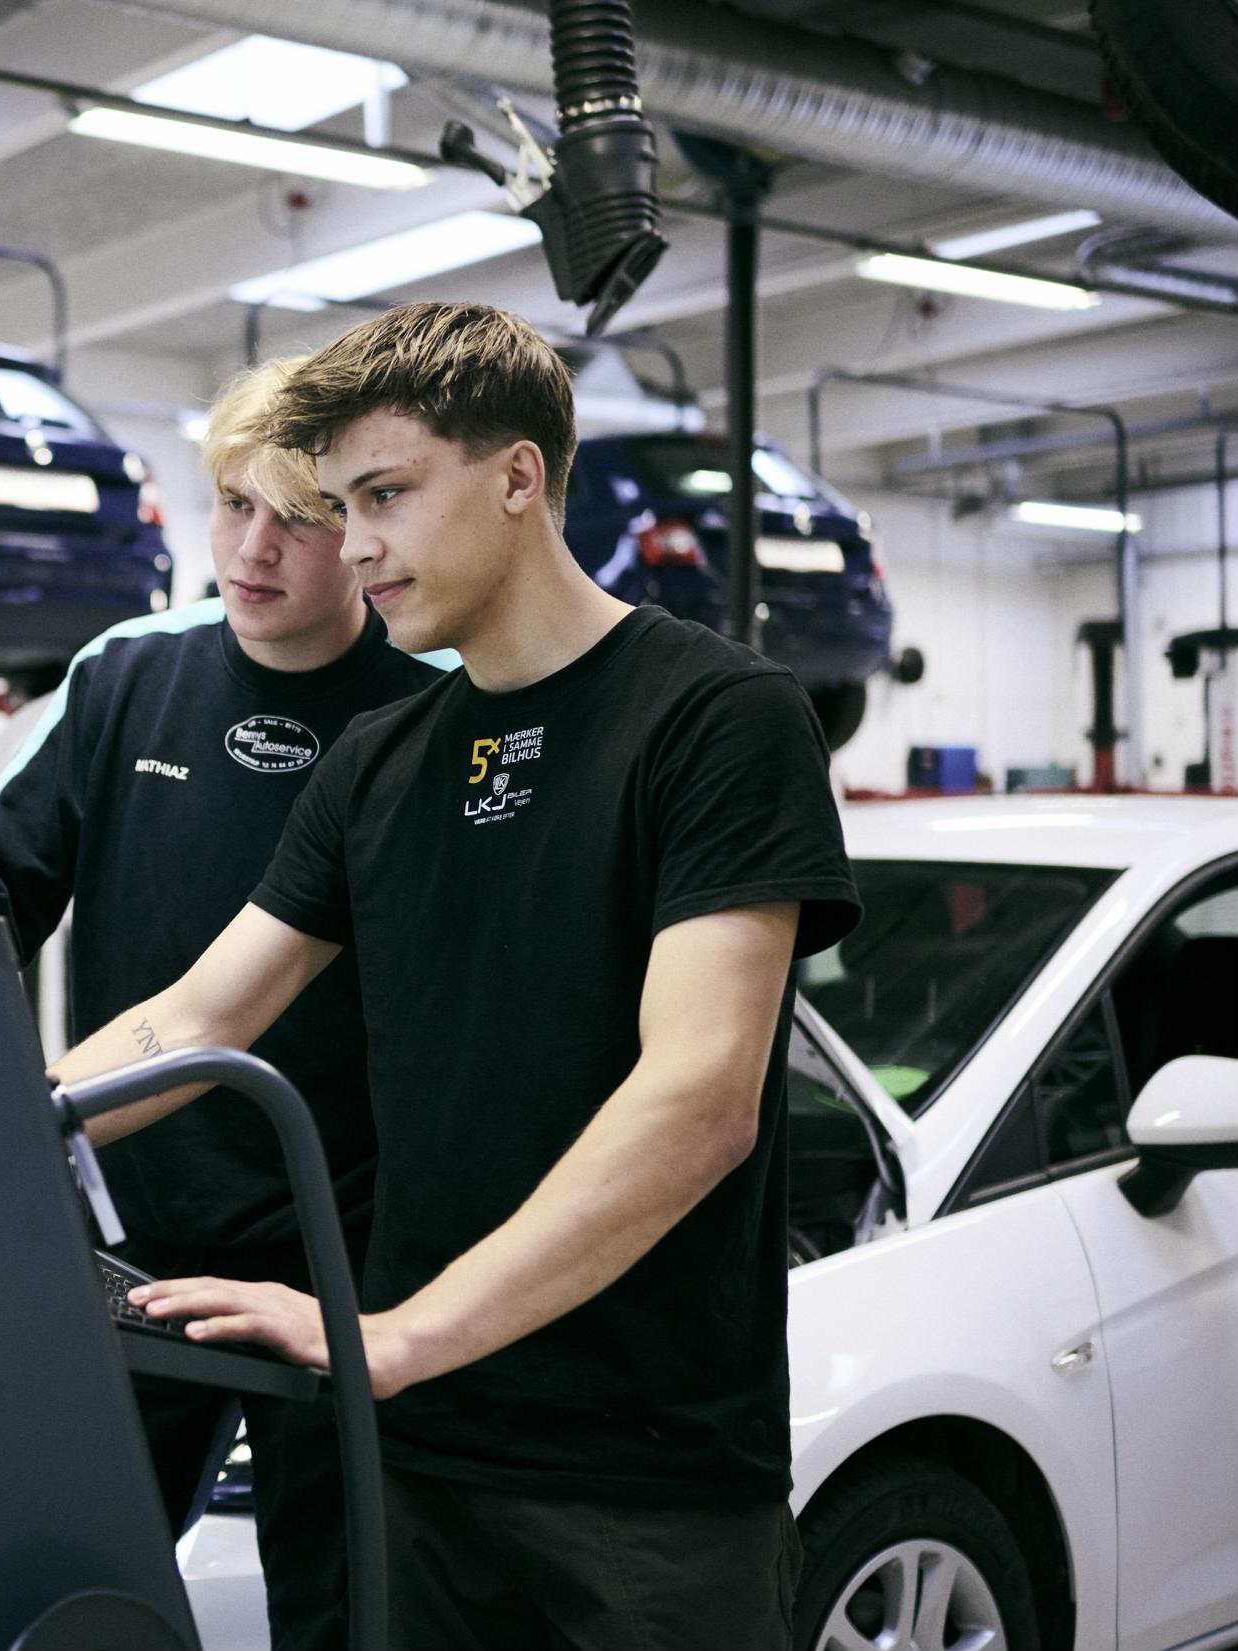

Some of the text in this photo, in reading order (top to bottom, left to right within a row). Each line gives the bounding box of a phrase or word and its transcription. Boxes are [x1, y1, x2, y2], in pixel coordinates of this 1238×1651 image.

[504, 726, 544, 743] MÆRKER
[503, 736, 543, 753] I SAMME
[501, 746, 541, 765] BILHUS
[464, 793, 507, 816] LKJ
